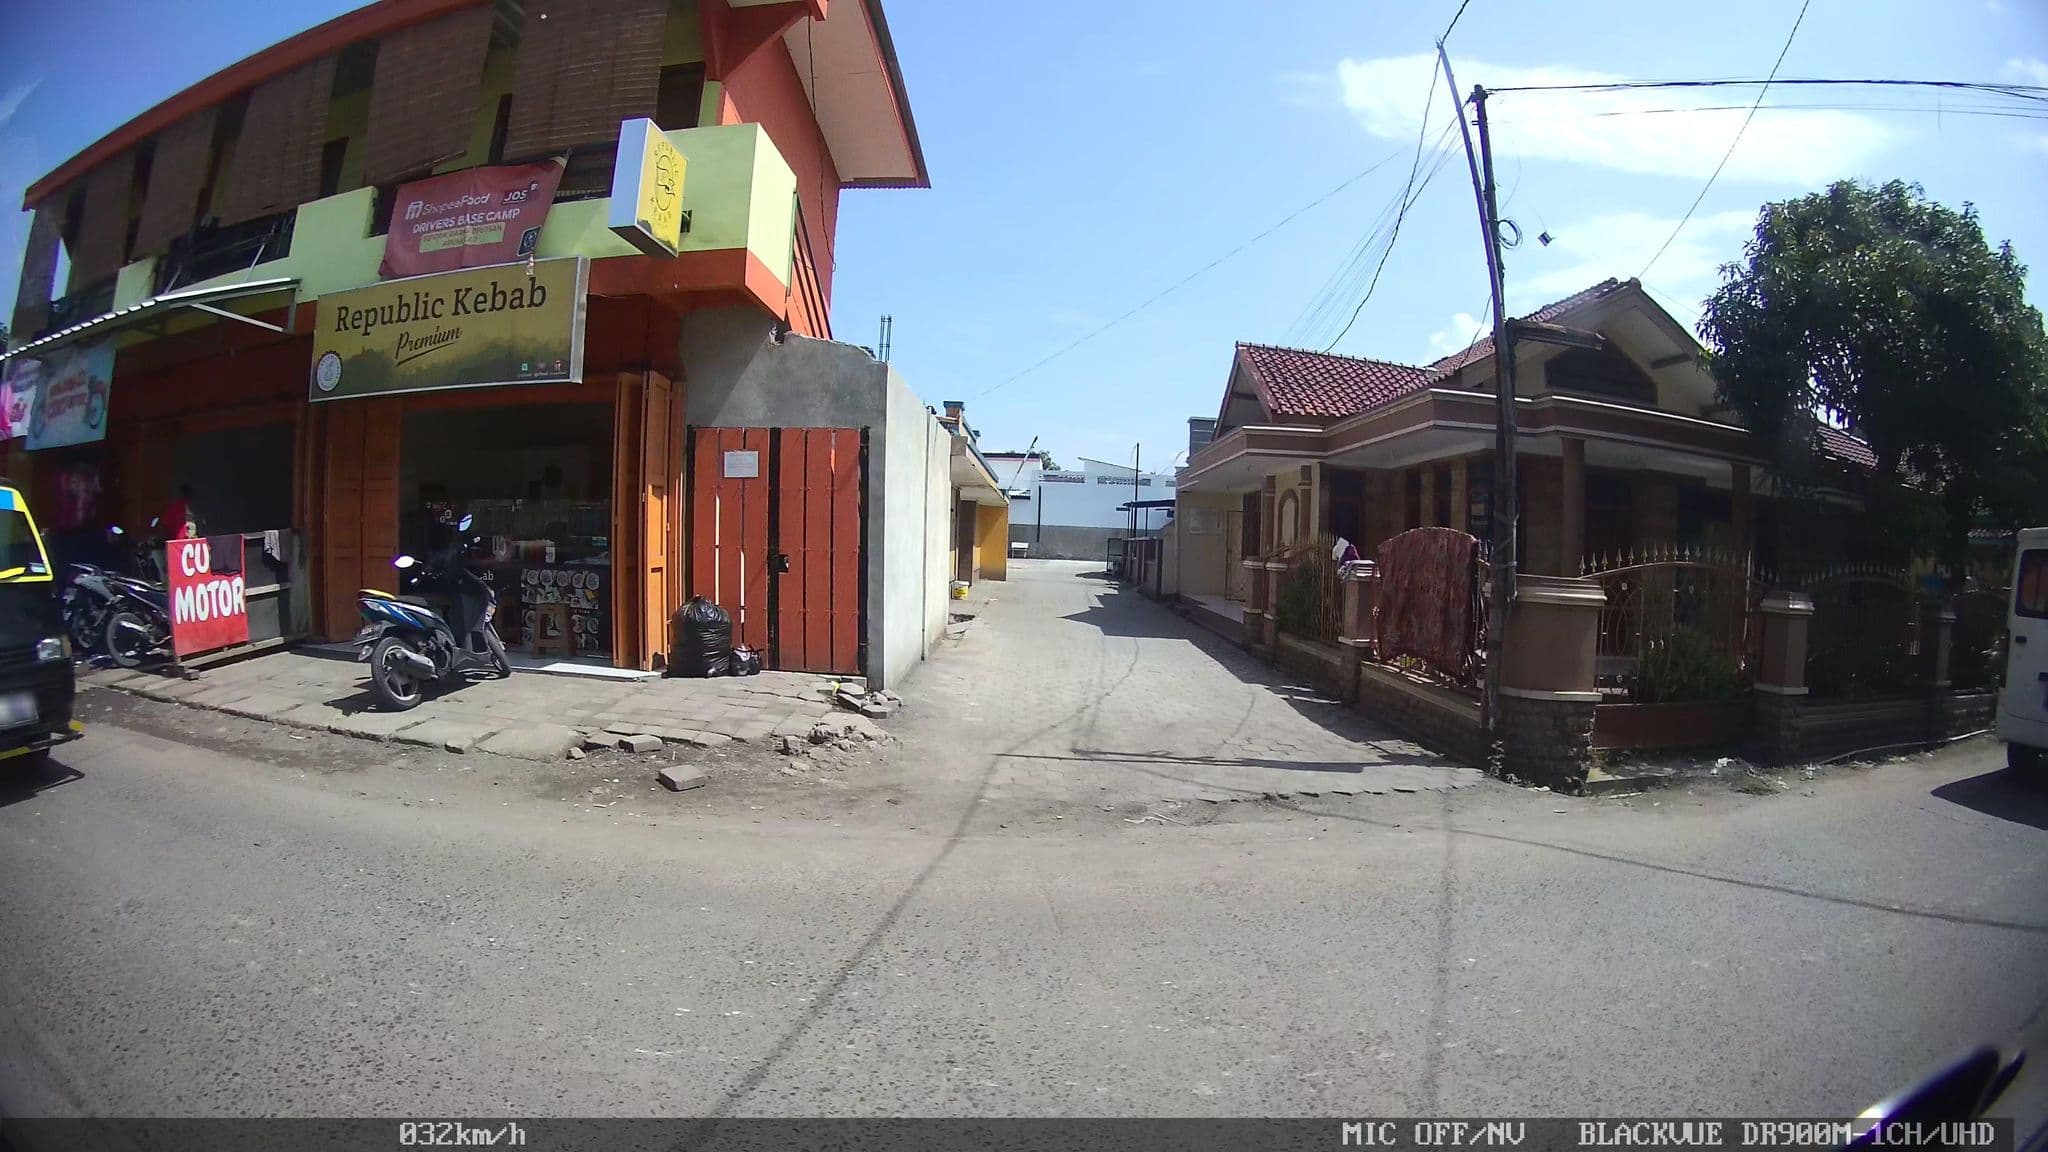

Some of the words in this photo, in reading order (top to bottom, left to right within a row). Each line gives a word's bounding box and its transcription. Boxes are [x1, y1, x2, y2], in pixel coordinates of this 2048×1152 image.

[422, 193, 491, 216] ShopeeFood
[504, 189, 528, 202] JOS
[412, 216, 455, 234] DRIVERS
[457, 212, 485, 226] BASE
[486, 208, 520, 222] CAMP
[335, 292, 445, 337] Republic
[451, 276, 547, 317] Kebab
[395, 326, 463, 361] Premium
[175, 576, 245, 625] MOTOR
